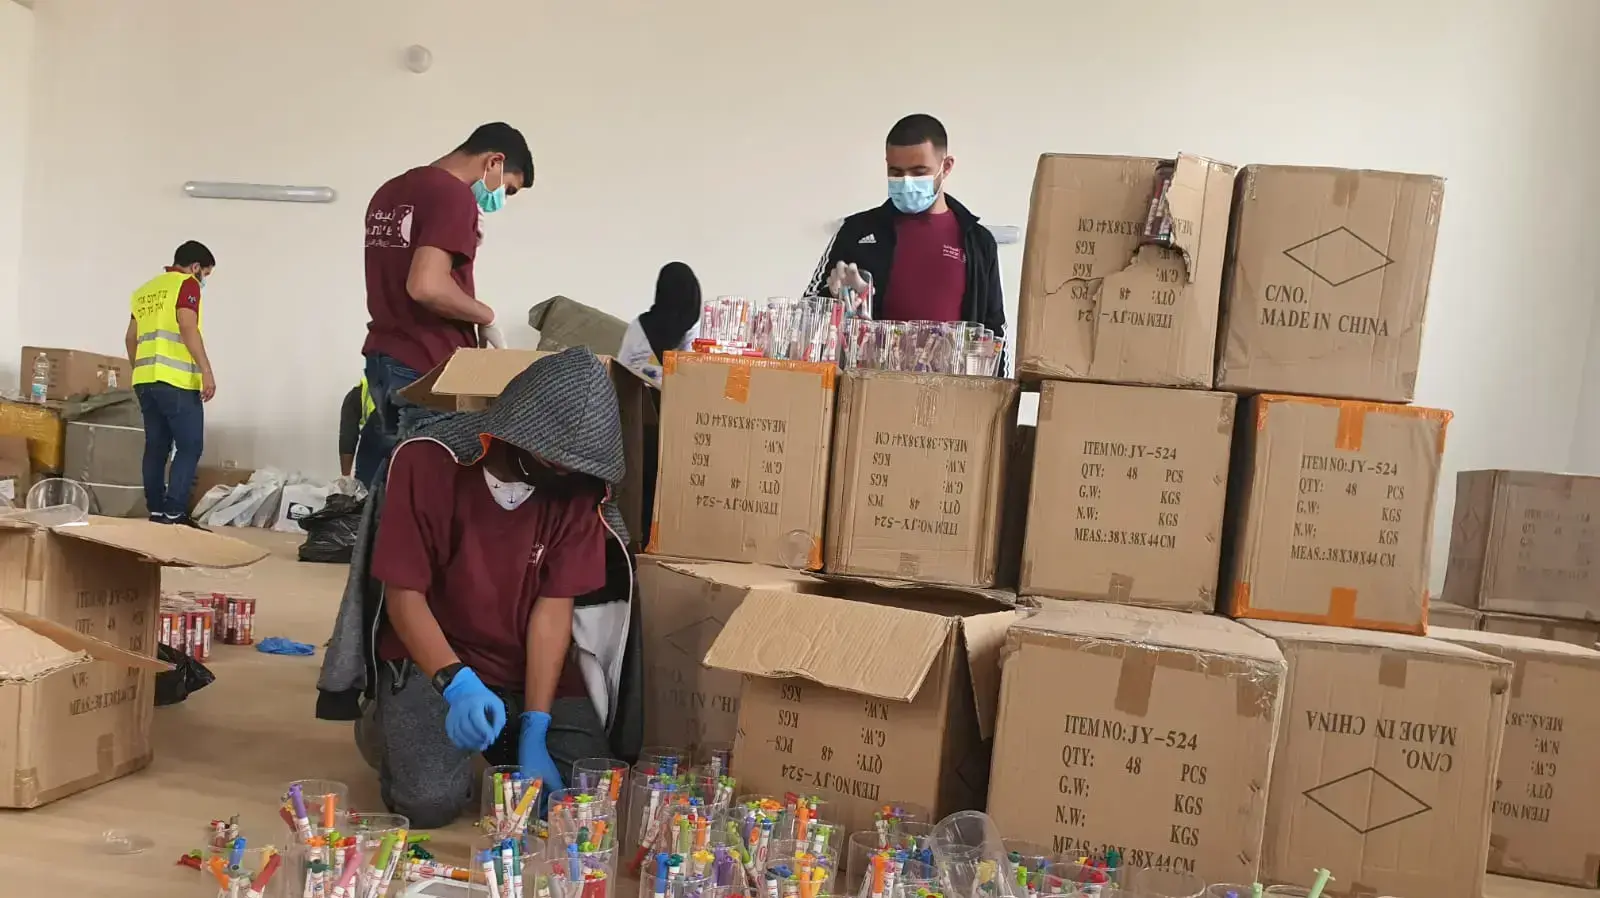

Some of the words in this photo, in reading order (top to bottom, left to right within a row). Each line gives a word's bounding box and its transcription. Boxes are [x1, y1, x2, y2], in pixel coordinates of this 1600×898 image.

[1075, 240, 1096, 255] KGS
[1073, 263, 1093, 277] KGS
[1071, 286, 1088, 300] PCS
[1119, 287, 1131, 300] 48
[1152, 289, 1175, 305] QTY:
[1265, 284, 1307, 304] C/NO.
[1261, 307, 1310, 328] MADE
[1313, 312, 1331, 330] IN
[1338, 314, 1388, 336] CHINA
[694, 432, 711, 446] KGS
[691, 452, 710, 467] KGS
[872, 452, 891, 466] KGS
[690, 473, 706, 487] PCS
[870, 473, 888, 487] KGS
[1081, 462, 1105, 479] QTY:
[1126, 466, 1138, 480] 48
[1165, 468, 1184, 483] PCS
[730, 477, 741, 489] 48
[759, 480, 780, 494] QTY:
[1299, 477, 1324, 494] QTY:
[1345, 482, 1357, 496] 48
[1386, 485, 1405, 500] PCS
[867, 493, 884, 507] PCS
[909, 497, 920, 510] 48
[1079, 485, 1101, 499] G.W:
[1160, 490, 1181, 505] KGS
[939, 499, 960, 515] QTY:
[1076, 505, 1098, 520] N.W:
[1158, 512, 1179, 527] KGS
[1296, 500, 1320, 514] G.W:
[1381, 507, 1402, 522] KGS
[1293, 521, 1317, 538] N.W:
[1378, 528, 1399, 545] KGS
[781, 683, 801, 703] KGS
[711, 695, 737, 713] CHI
[864, 699, 889, 720] N.W:
[778, 709, 799, 728] KGS
[1306, 709, 1366, 736] CHINA
[1376, 717, 1396, 739] IN
[1400, 720, 1458, 746] MADE
[775, 735, 794, 753] PCS
[861, 727, 886, 748] G.W:
[1534, 738, 1560, 755] N.W:
[821, 745, 834, 761] 48
[1402, 749, 1453, 772] C/NO.
[857, 752, 883, 775] QTY:
[1062, 745, 1095, 767] QTY:
[1125, 755, 1142, 775] 48
[1180, 763, 1207, 785] PCS
[1531, 760, 1556, 777] G.W:
[1496, 779, 1503, 792] 4
[1527, 782, 1553, 800] QTY:
[1059, 775, 1089, 797] G.W:
[1173, 793, 1204, 816] KGS
[1055, 805, 1086, 828] N.W:
[1169, 824, 1200, 847] KGS
